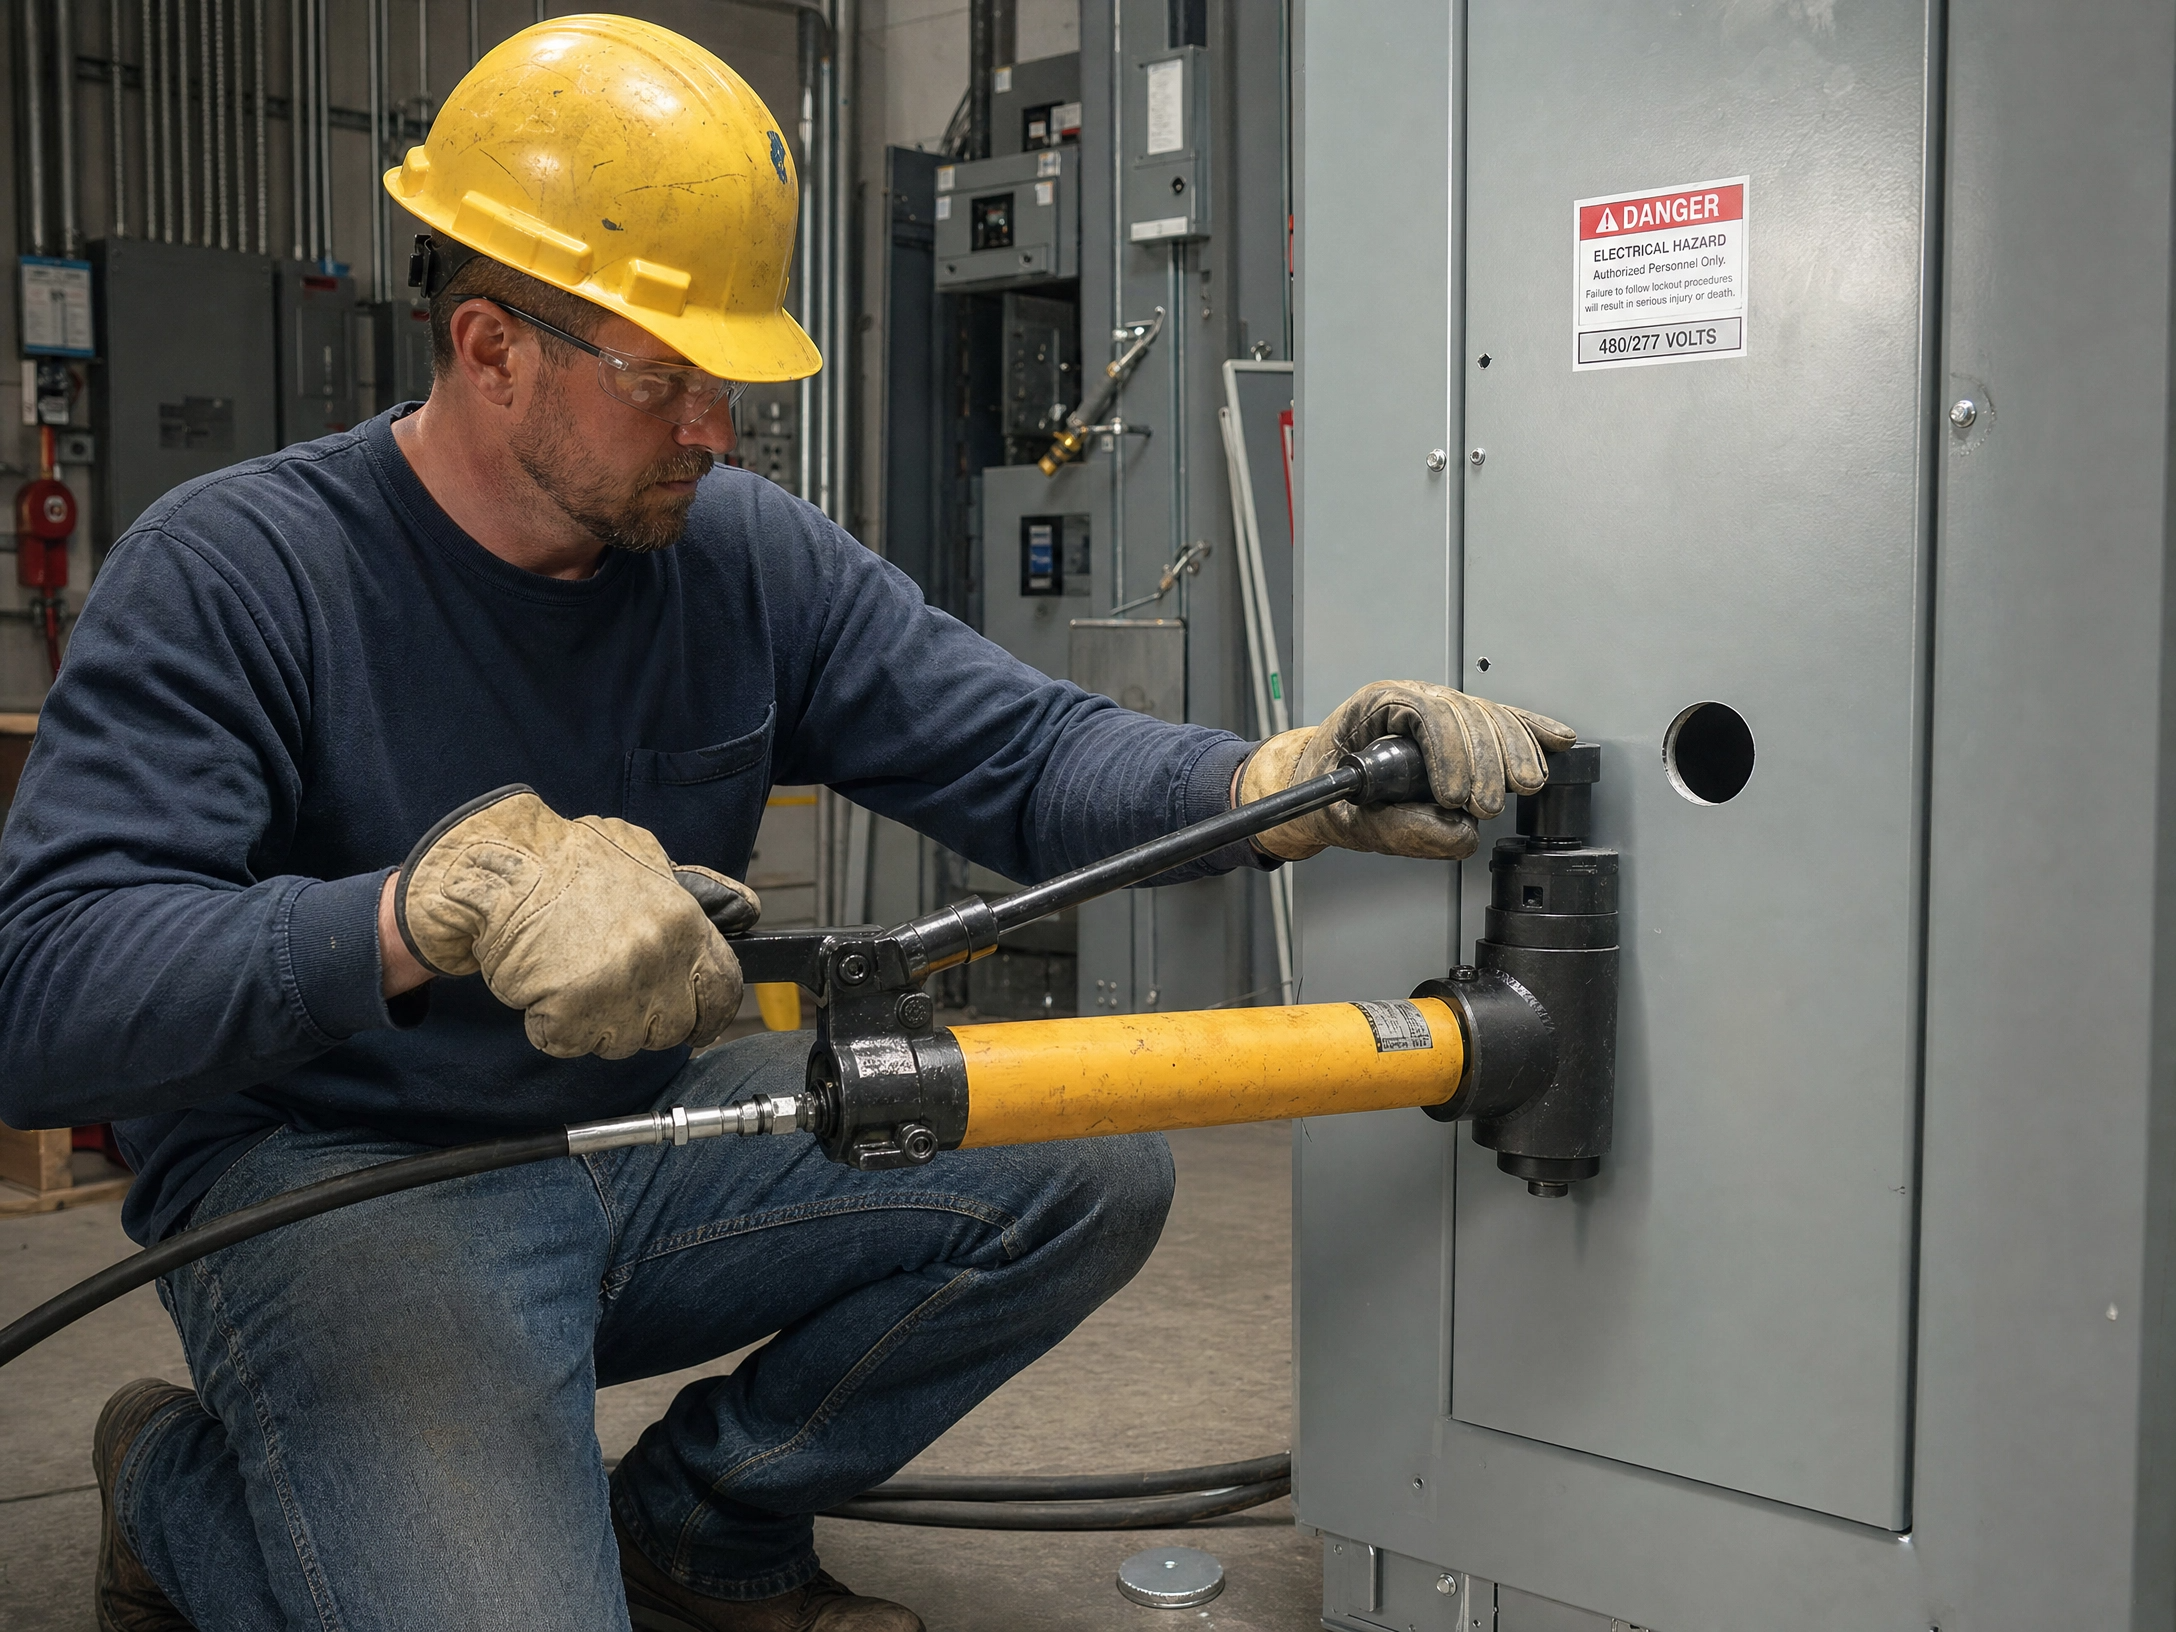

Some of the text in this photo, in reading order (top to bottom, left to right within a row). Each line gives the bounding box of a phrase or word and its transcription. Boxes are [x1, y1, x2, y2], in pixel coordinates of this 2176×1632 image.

[1623, 194, 1719, 229] DANGER
[1594, 234, 1726, 262] ELECTRICAL HAZARD
[1593, 255, 1726, 280] Authorized Personnel Only.
[1586, 275, 1733, 298] Failure to follow lockout procedures
[1585, 302, 1598, 312] will
[1601, 299, 1624, 311] result
[1626, 300, 1633, 308] in
[1636, 296, 1667, 307] serious
[1670, 292, 1692, 305] injury
[1707, 288, 1735, 299] death.
[1599, 328, 1717, 354] 480/277 VOLTS
